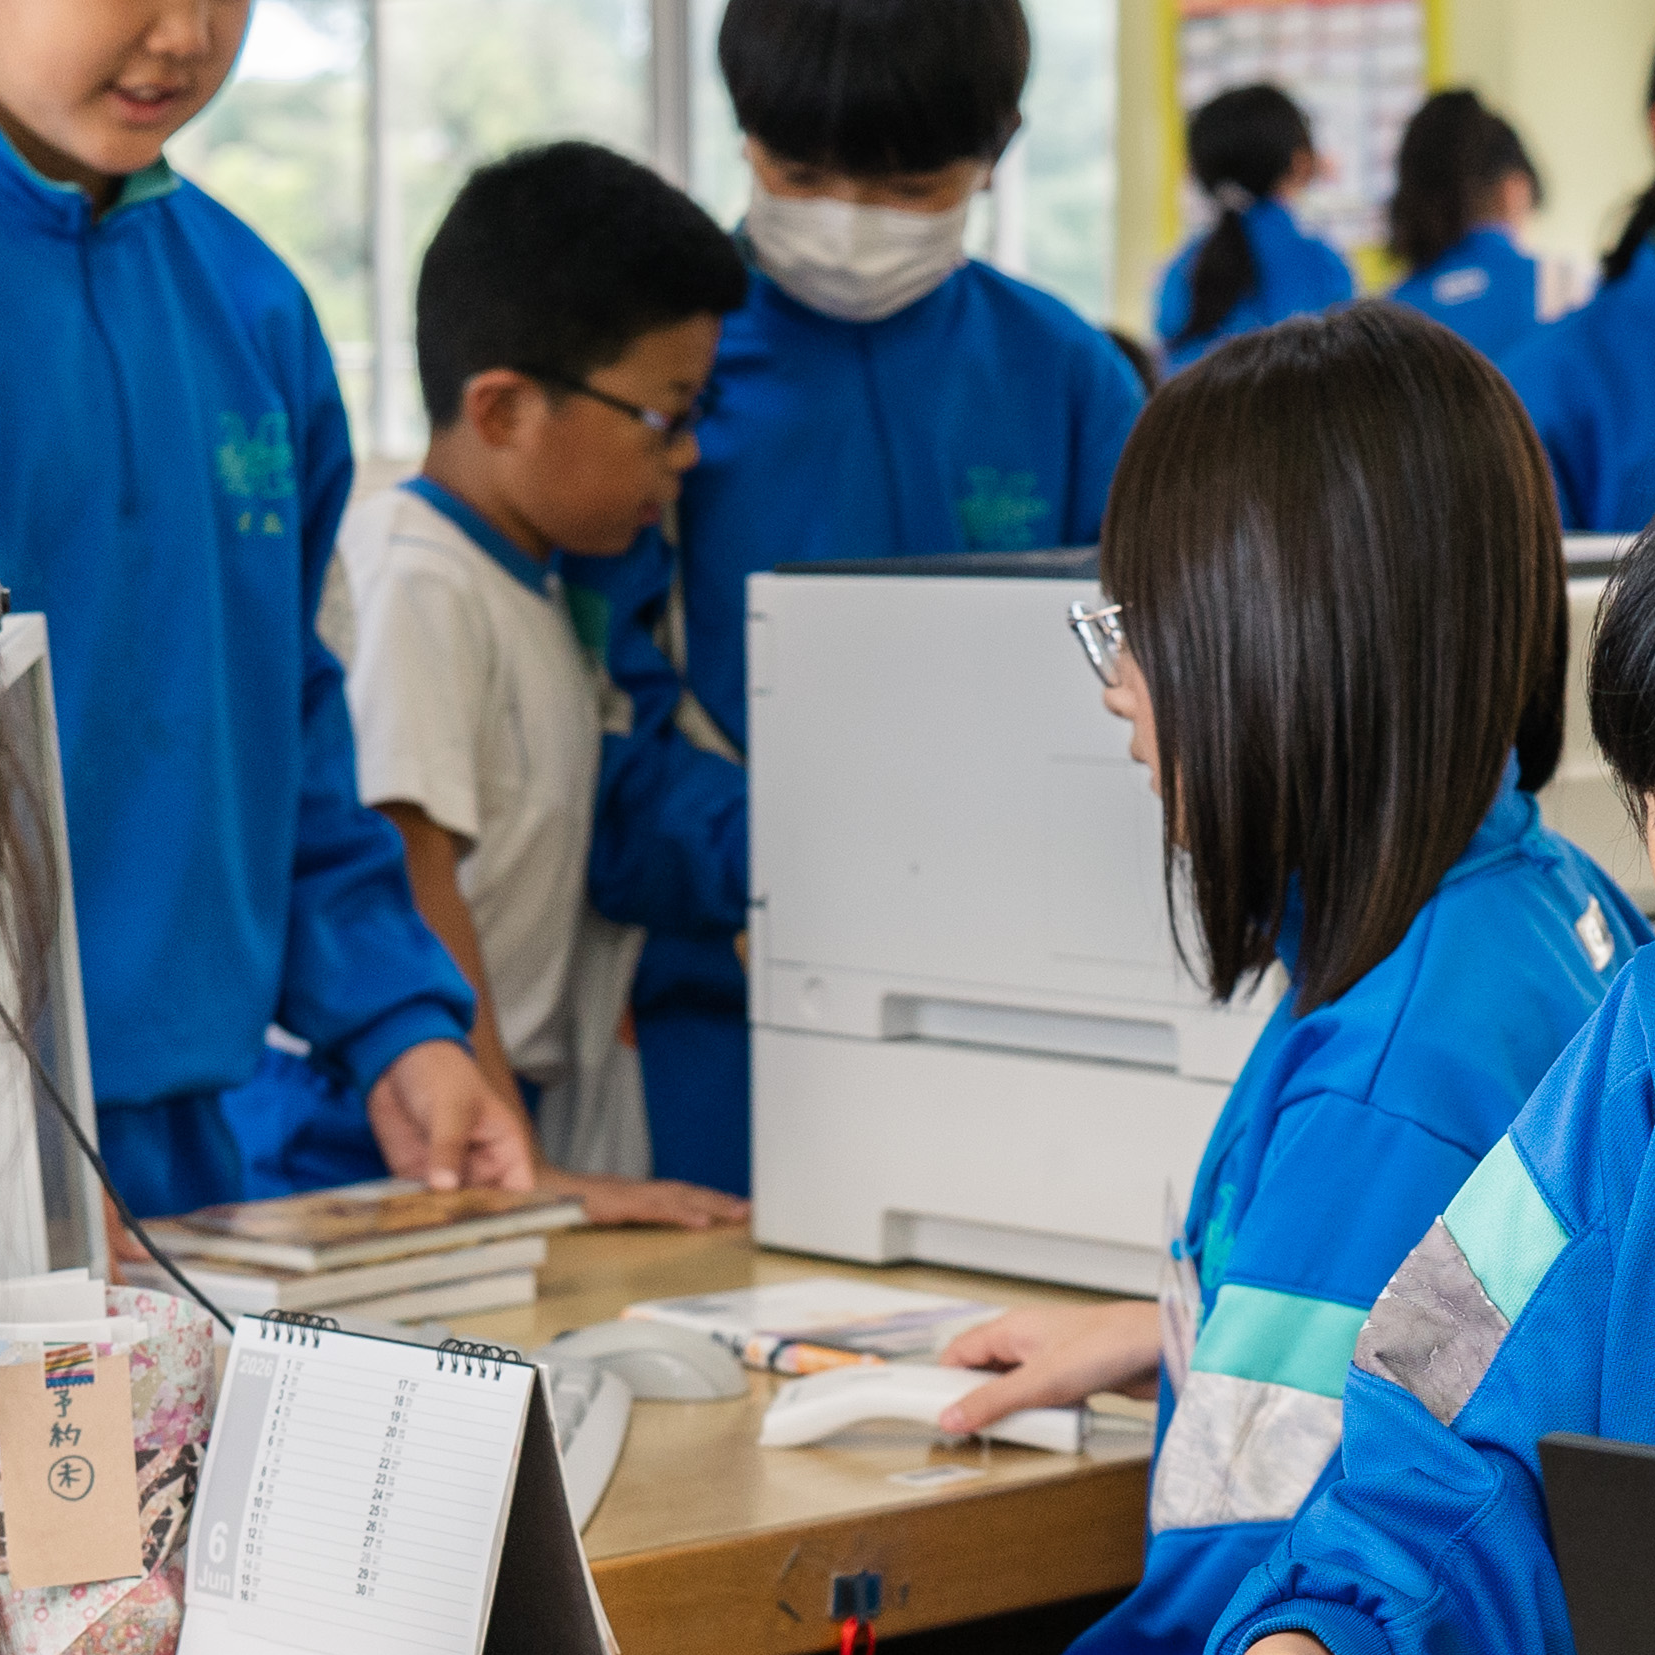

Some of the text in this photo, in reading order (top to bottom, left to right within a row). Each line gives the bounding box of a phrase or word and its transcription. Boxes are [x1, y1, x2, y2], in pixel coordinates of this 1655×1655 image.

[240, 1354, 275, 1378] 2026
[286, 1360, 291, 1370] 1
[281, 1375, 288, 1386] 2
[398, 1379, 408, 1391] 17
[278, 1390, 284, 1400] 3
[394, 1395, 404, 1407] 18
[274, 1405, 281, 1416] 4
[390, 1410, 400, 1422] 19
[49, 1388, 82, 1448] 予約
[271, 1420, 277, 1431] 5
[386, 1426, 397, 1438] 20
[268, 1436, 273, 1447] 6
[379, 1457, 390, 1469] 22
[261, 1466, 267, 1477] 8
[375, 1473, 387, 1485] 23
[257, 1482, 263, 1493] 9
[372, 1489, 383, 1500] 24
[253, 1497, 262, 1508] 10
[369, 1505, 380, 1516] 25
[250, 1513, 259, 1523] 11
[366, 1520, 377, 1532] 26
[248, 1528, 257, 1539] 12
[208, 1520, 230, 1564] 6
[363, 1536, 374, 1547] 27
[245, 1543, 254, 1555] 13
[357, 1568, 369, 1579] 29
[198, 1565, 232, 1594] Jun
[242, 1574, 251, 1586] 15
[356, 1584, 367, 1595] 30
[240, 1590, 249, 1601] 16
